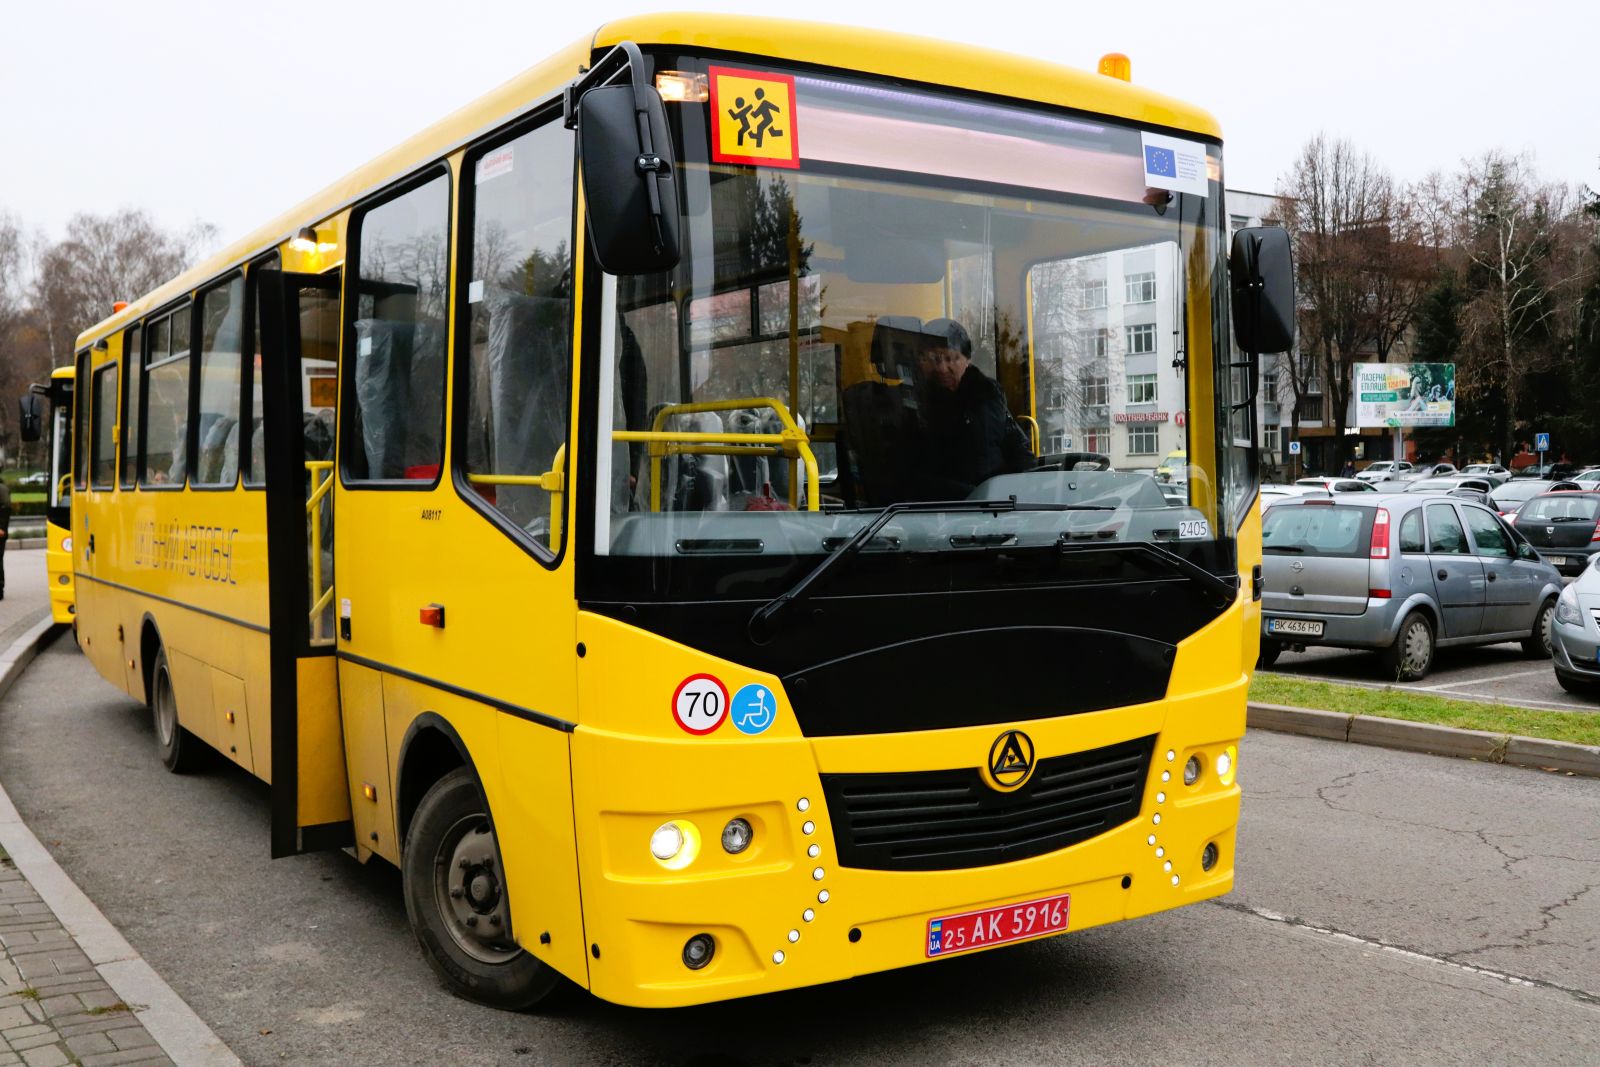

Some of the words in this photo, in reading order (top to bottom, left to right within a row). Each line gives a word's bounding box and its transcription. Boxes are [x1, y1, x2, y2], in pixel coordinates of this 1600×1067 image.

[1361, 373, 1387, 381] ЛАЗЕРНА
[1180, 521, 1207, 537] 2405
[1274, 620, 1287, 631] BK
[1287, 621, 1306, 632] 4636
[1308, 623, 1321, 633] HO
[685, 691, 719, 718] 70
[944, 929, 965, 949] 25
[971, 912, 1004, 943] AK
[1011, 900, 1062, 936] 5916
[930, 940, 941, 951] UA
